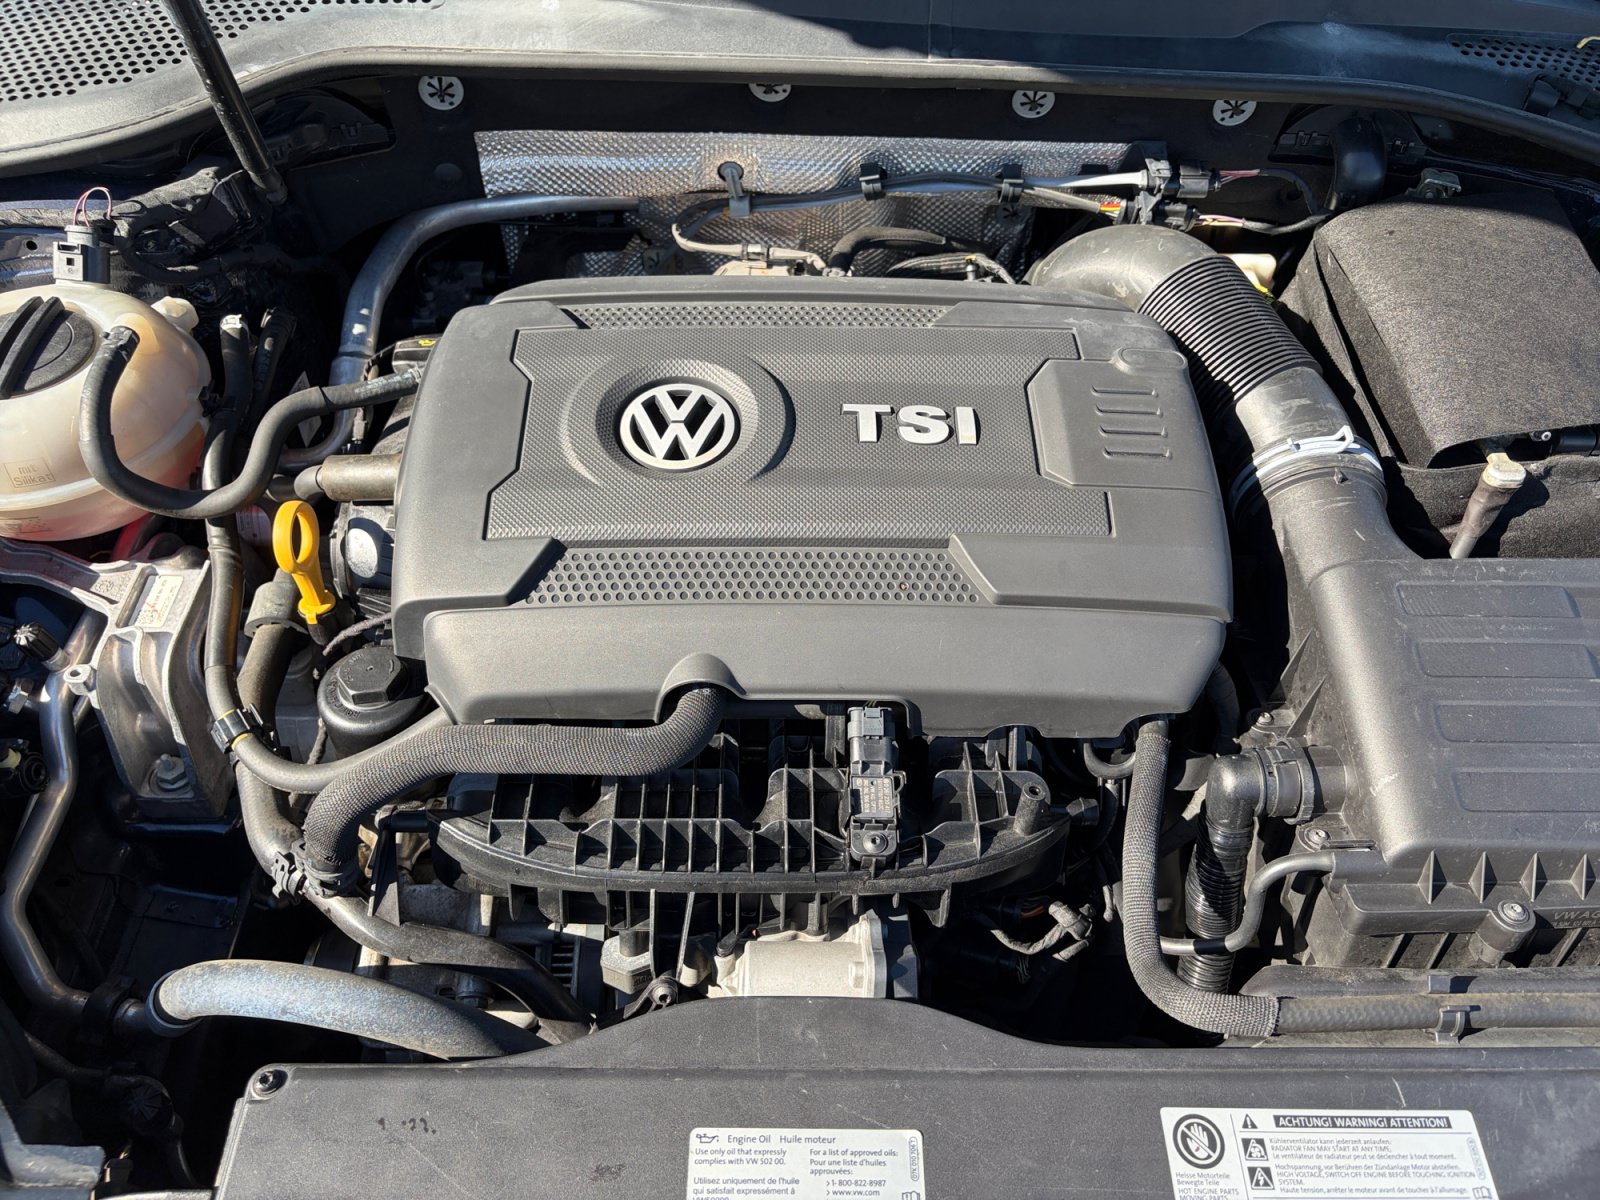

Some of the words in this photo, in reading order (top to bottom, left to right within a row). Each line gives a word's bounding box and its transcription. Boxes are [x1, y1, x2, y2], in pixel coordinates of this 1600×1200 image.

[619, 383, 736, 470] VW
[840, 403, 979, 445] TSI
[13, 473, 52, 486] Silikat
[1279, 1117, 1332, 1127] ACHTUNG!
[1334, 1117, 1388, 1127] WARNING!
[1390, 1118, 1448, 1128] ATTENTION!
[728, 1135, 756, 1145] Engine
[759, 1134, 771, 1144] Oil
[780, 1134, 802, 1144] Huile
[710, 1148, 725, 1157] only
[754, 1148, 787, 1157] expressly
[850, 1149, 882, 1157] approved
[694, 1158, 726, 1166] complies
[722, 1177, 766, 1186] uniquement
[693, 1187, 704, 1196] qui
[736, 1187, 788, 1196] expressément
